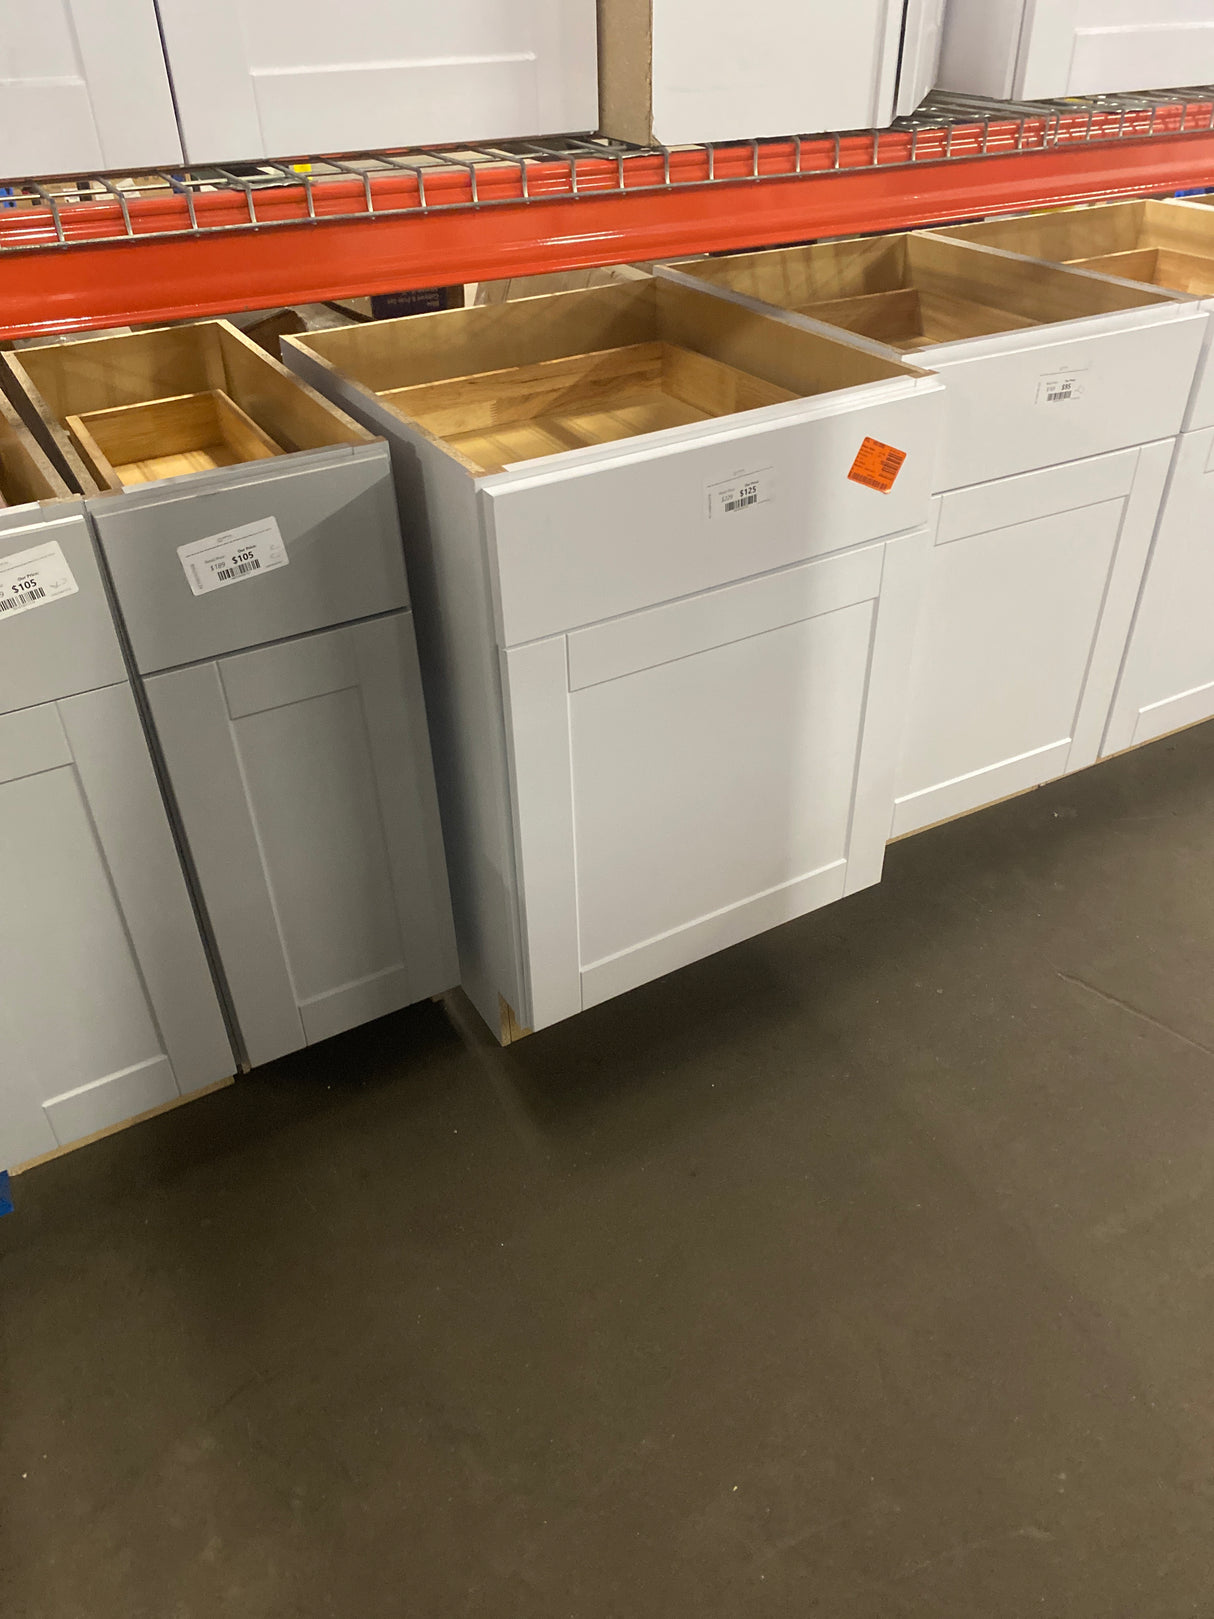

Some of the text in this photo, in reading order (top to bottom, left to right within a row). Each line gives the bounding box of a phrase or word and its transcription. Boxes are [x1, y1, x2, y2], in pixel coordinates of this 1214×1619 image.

[740, 485, 757, 497] $125
[232, 551, 254, 565] $105
[11, 579, 37, 594] $105
